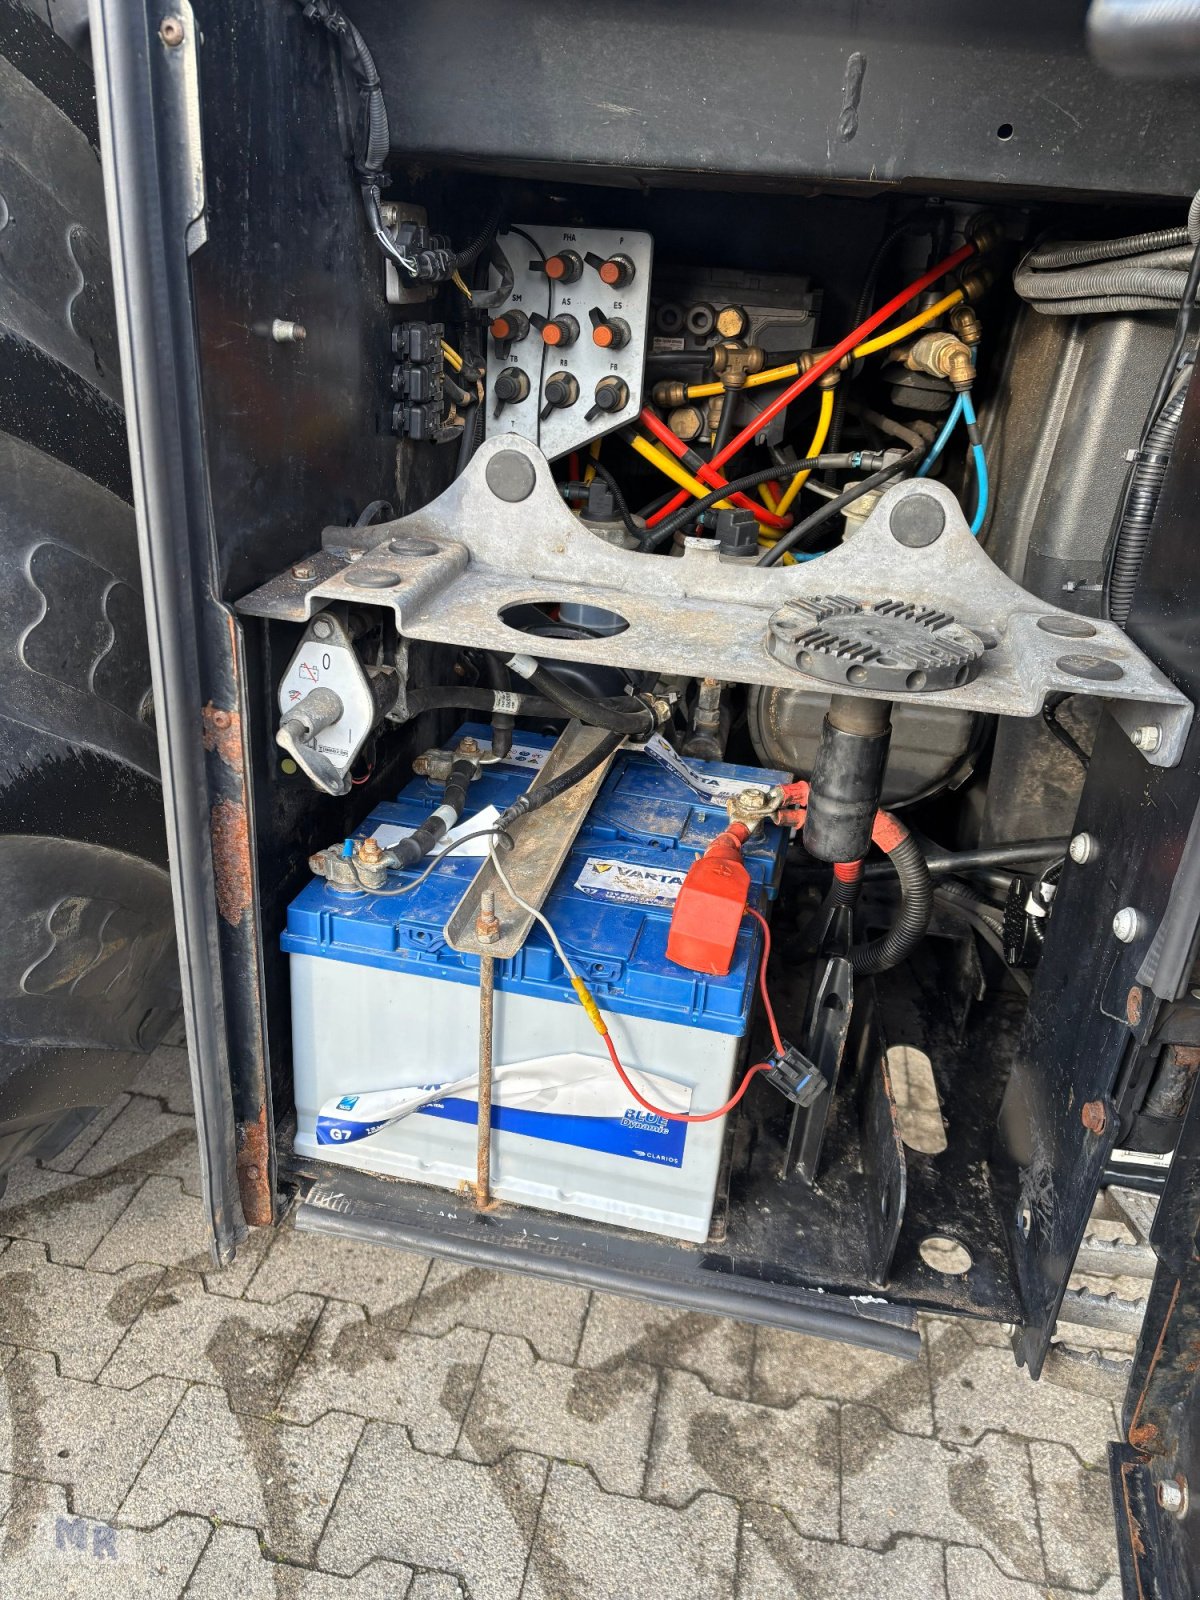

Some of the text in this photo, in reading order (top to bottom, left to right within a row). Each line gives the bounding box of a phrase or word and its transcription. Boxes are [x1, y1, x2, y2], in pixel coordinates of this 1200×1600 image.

[563, 233, 577, 242] PHA
[512, 294, 523, 303] SM
[561, 298, 572, 306] AS
[613, 302, 623, 310] ES
[510, 355, 519, 363] TB
[609, 363, 619, 371] FB
[510, 420, 516, 428] T
[617, 866, 683, 885] VARTA
[624, 1108, 669, 1127] BLUE
[621, 1118, 670, 1135] Dynamic
[329, 1128, 352, 1141] G7
[646, 1152, 679, 1164] CLARIOS
